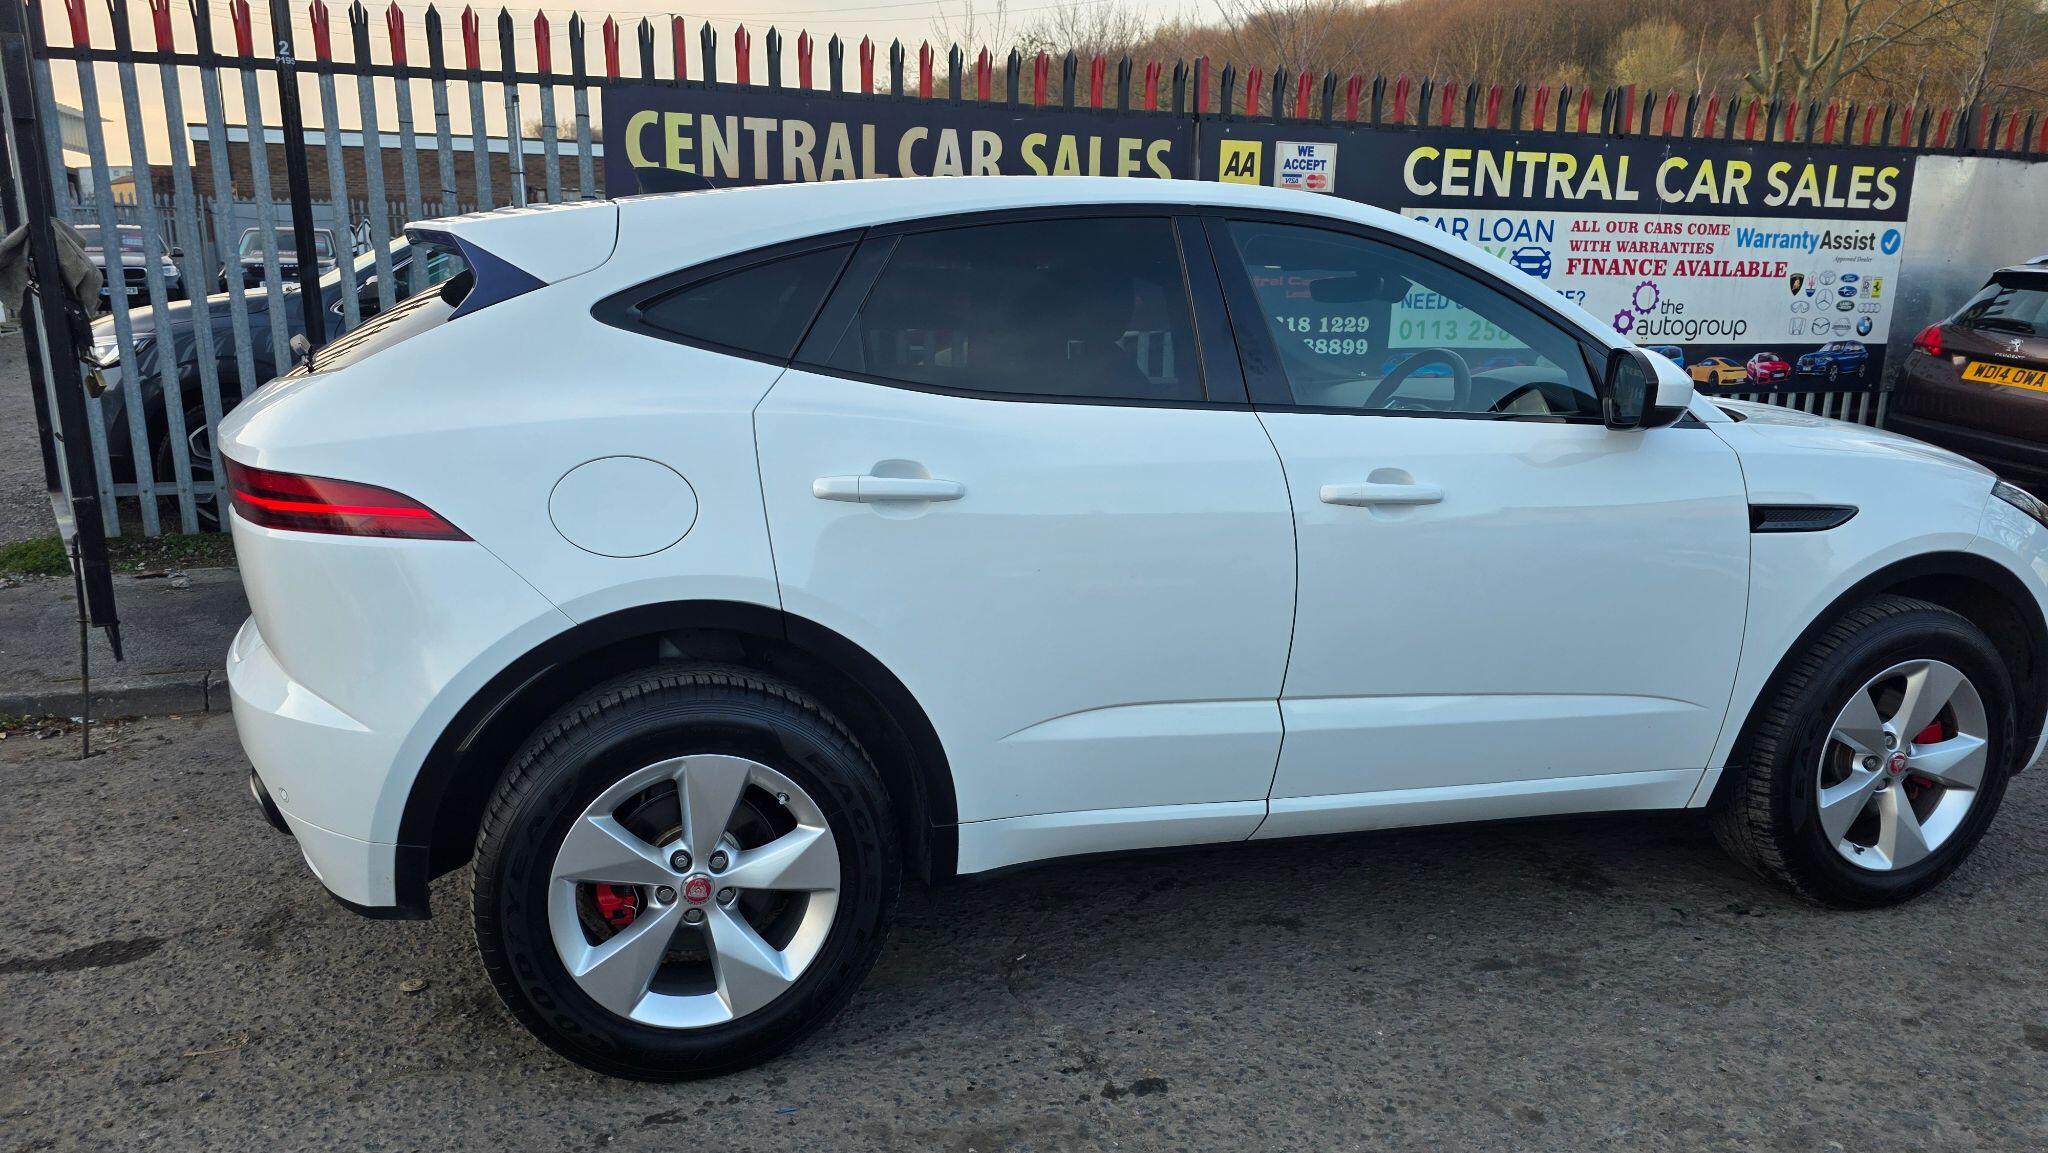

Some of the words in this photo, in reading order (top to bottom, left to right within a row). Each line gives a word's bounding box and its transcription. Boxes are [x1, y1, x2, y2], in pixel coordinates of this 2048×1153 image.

[279, 41, 290, 55] 2
[625, 110, 888, 181] CENTRAL
[898, 127, 1003, 178] CAR
[1021, 133, 1172, 179] SALES
[1298, 146, 1314, 157] WE
[1224, 151, 1255, 177] AA
[1283, 159, 1327, 171] ACCEPT
[1403, 146, 1639, 201] CENTRAL
[1655, 156, 1752, 205] CAR
[1763, 161, 1900, 211] SALES
[1479, 218, 1555, 243] LOAN
[1571, 220, 1600, 233] ALL
[1605, 221, 1639, 234] OUR
[1644, 221, 1683, 235] CARS
[1687, 223, 1731, 236] COME
[1569, 240, 1611, 253] WITH
[1616, 241, 1715, 255] WARRANTIES
[1565, 258, 1668, 277] FINANCE
[1673, 260, 1788, 279] AVAILABLE
[1401, 293, 1450, 310] NEED
[1661, 299, 1684, 315] the
[1319, 316, 1370, 333] 1229
[1399, 319, 1458, 341] 0113
[1636, 316, 1747, 341] autogroup
[1973, 363, 2011, 381] WD14
